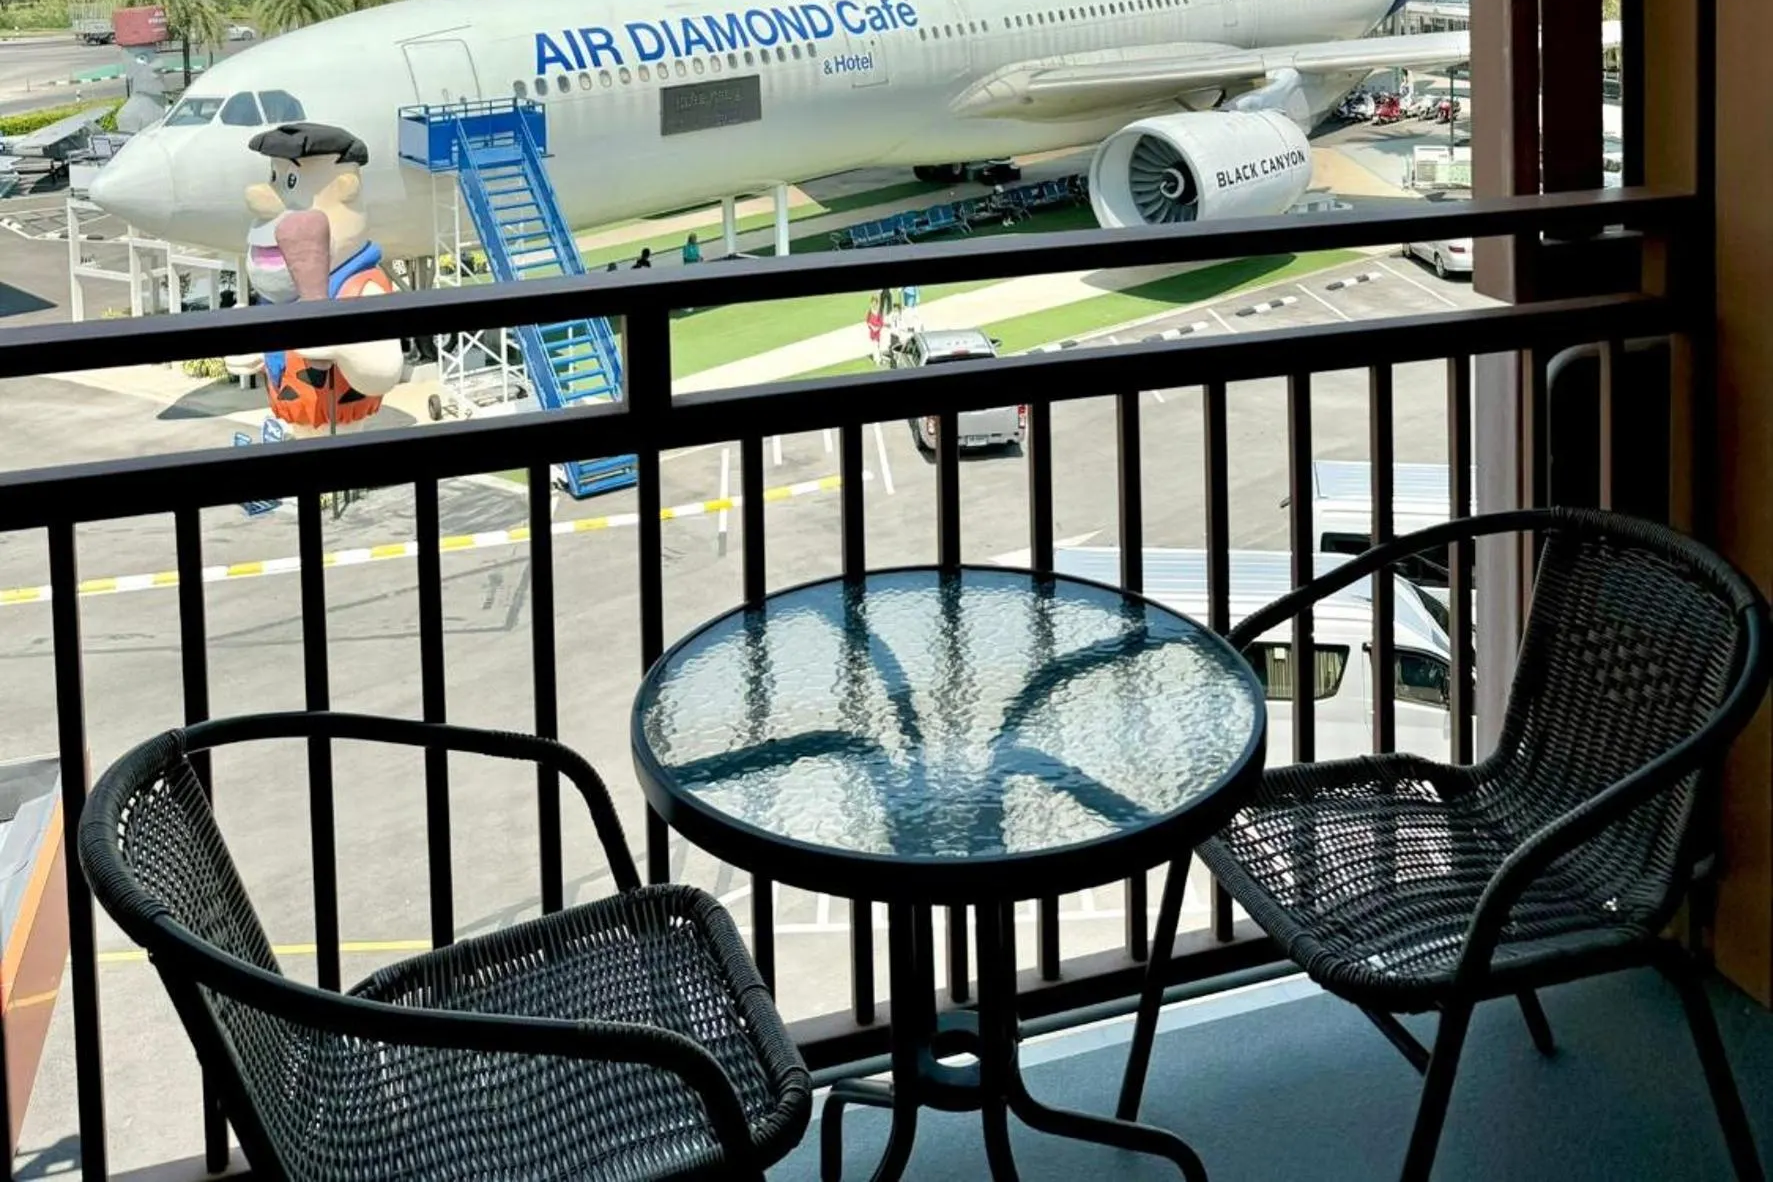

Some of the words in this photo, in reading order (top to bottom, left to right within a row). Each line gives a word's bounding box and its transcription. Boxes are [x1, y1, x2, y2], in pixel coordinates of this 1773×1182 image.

[535, 26, 624, 75] AIR
[624, 3, 834, 62] DIAMOND
[823, 59, 833, 75] &
[833, 52, 874, 73] Hotel
[1216, 162, 1259, 188] BLACK
[1260, 149, 1306, 175] CANYON
